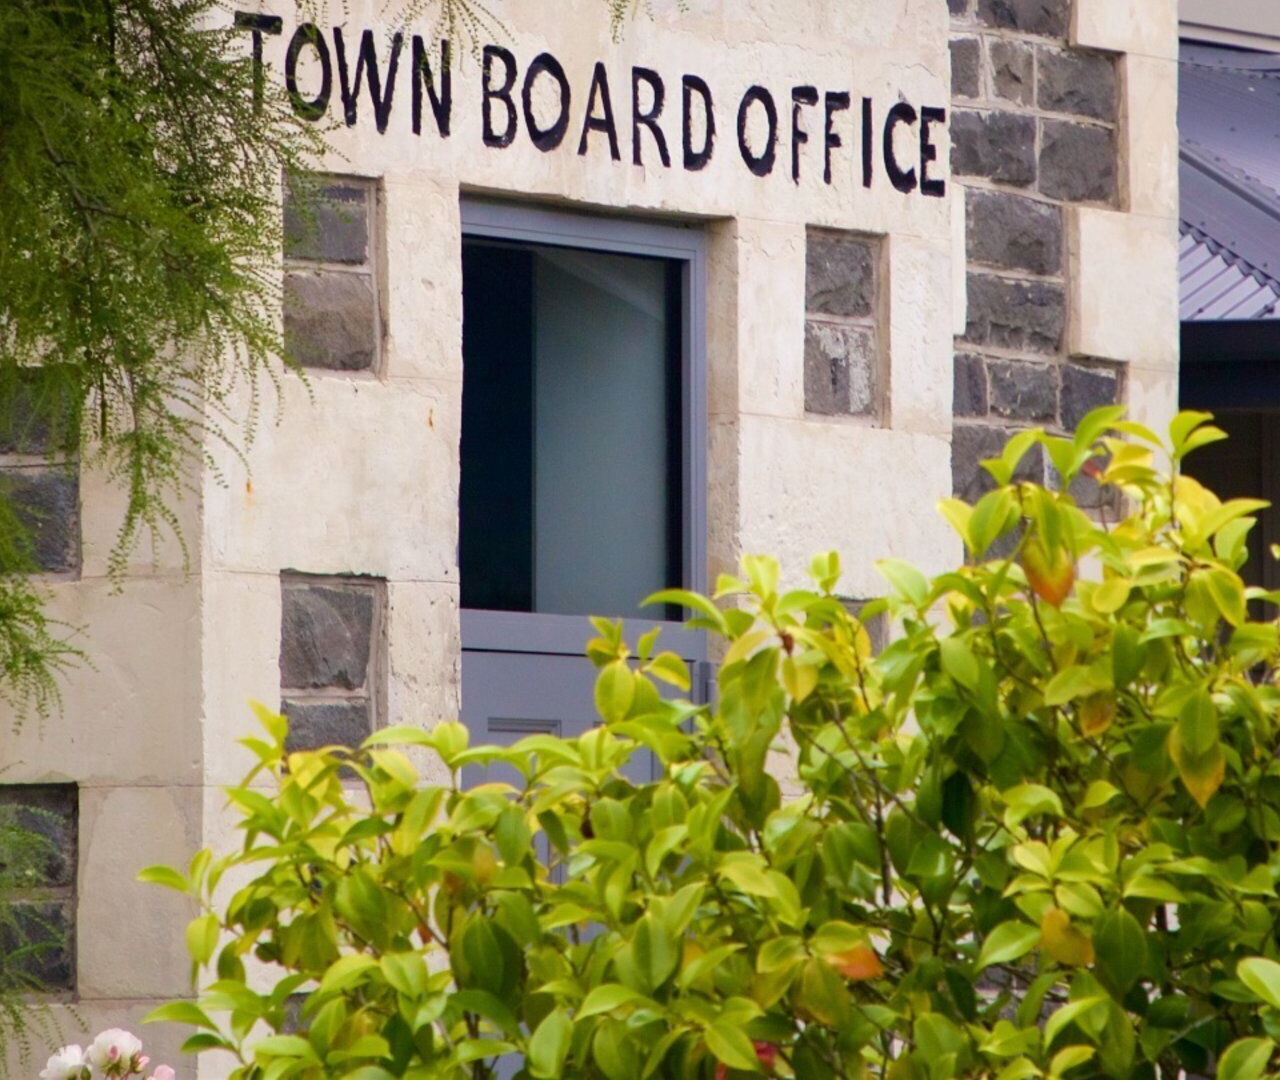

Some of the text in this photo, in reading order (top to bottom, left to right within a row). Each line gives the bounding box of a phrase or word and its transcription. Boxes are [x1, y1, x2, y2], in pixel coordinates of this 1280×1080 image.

[234, 10, 947, 198] TOWN BOARD OFFICE
